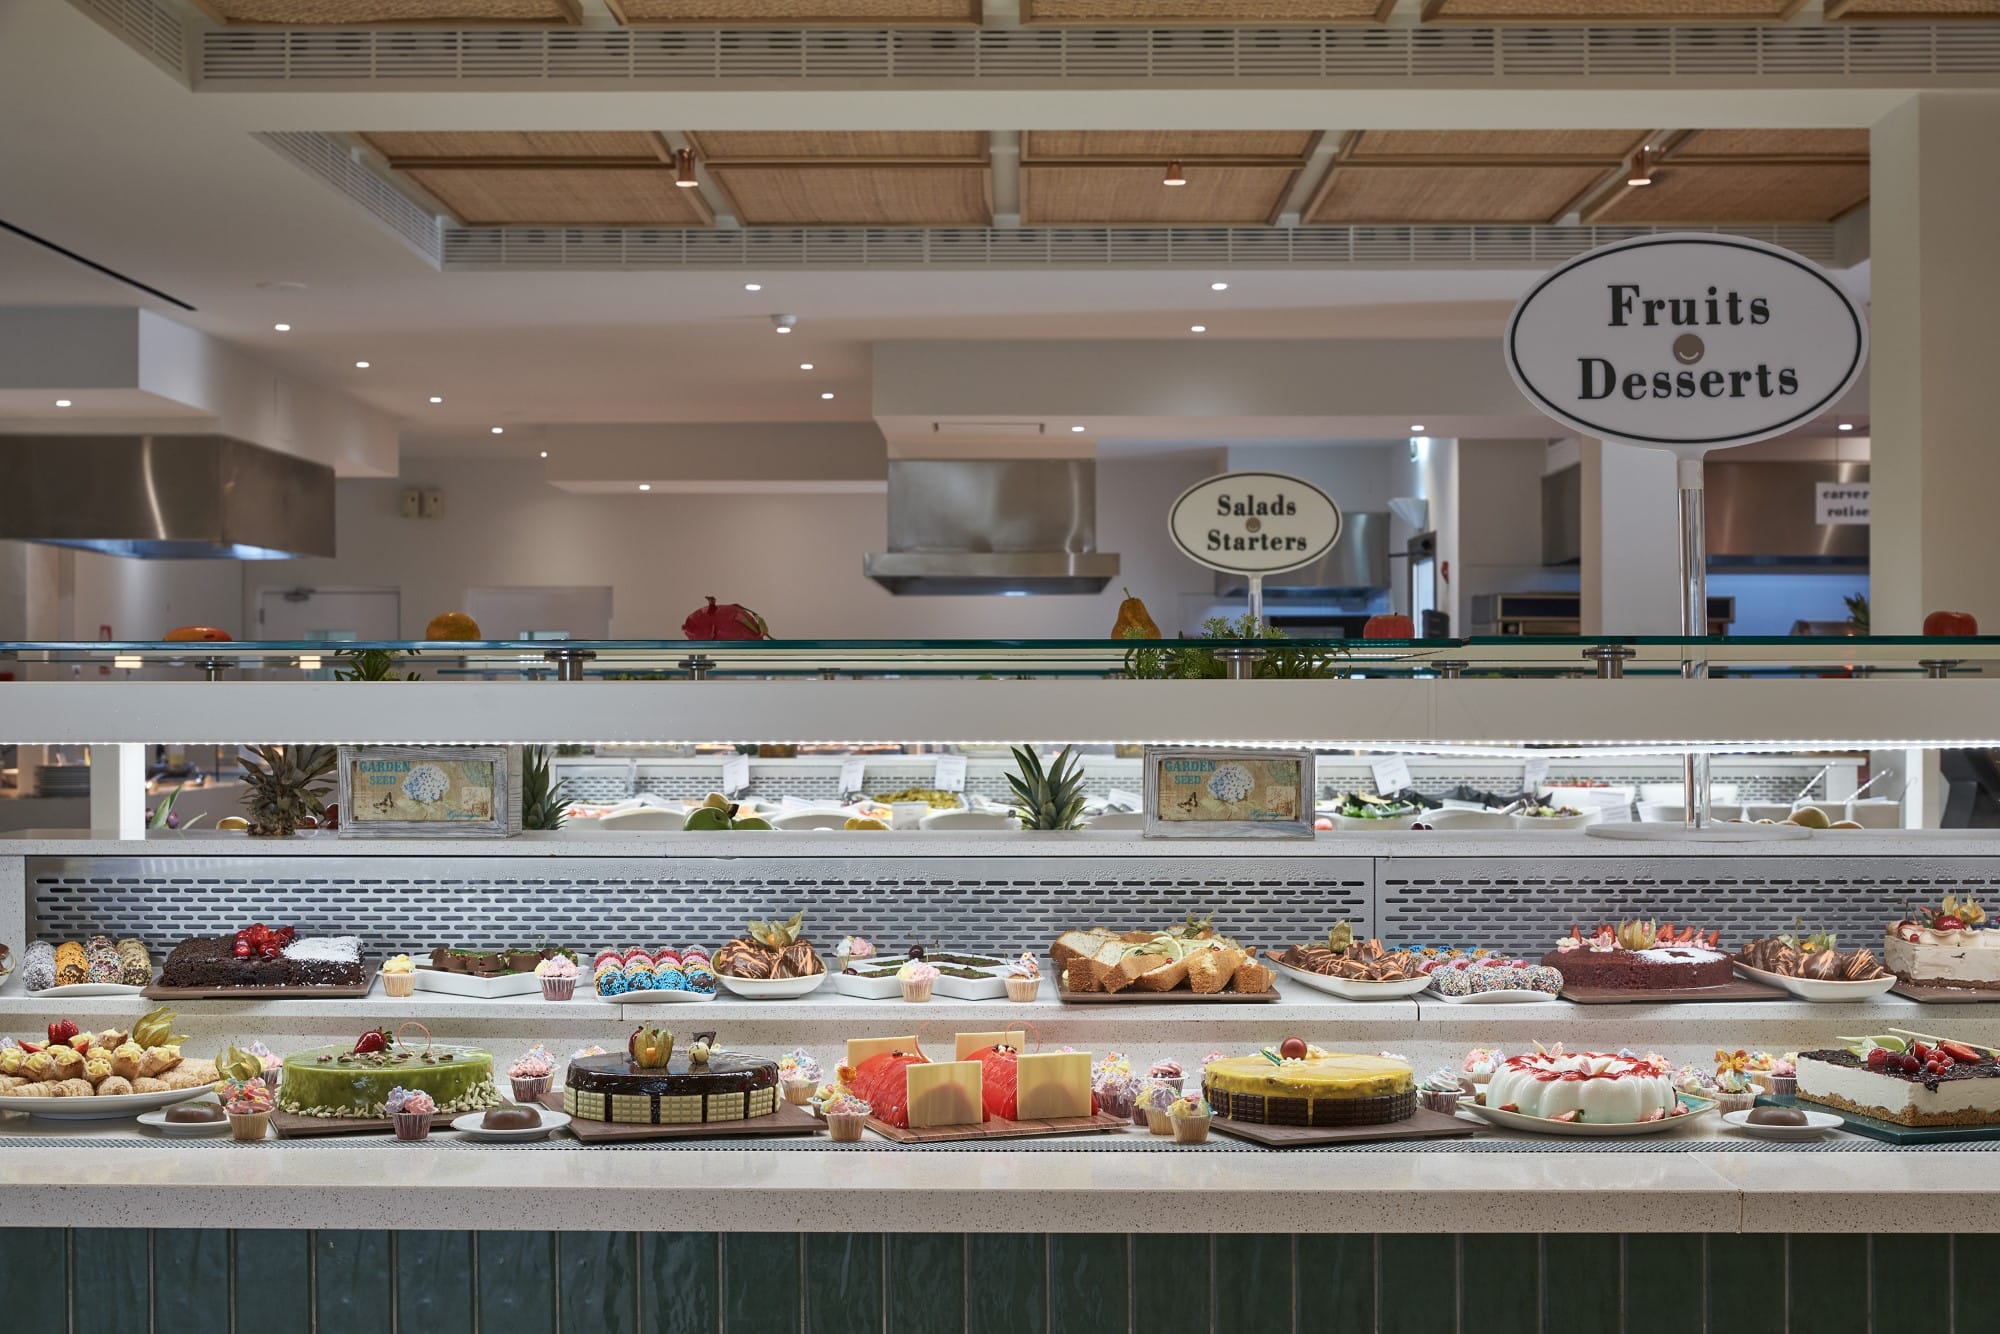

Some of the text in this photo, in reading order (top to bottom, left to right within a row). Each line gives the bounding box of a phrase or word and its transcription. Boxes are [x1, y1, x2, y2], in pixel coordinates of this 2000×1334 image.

[1607, 284, 1771, 327] Fruits
[1576, 357, 1800, 401] Desserts
[1217, 493, 1297, 516] Salads
[1207, 528, 1307, 551] Starters
[358, 760, 411, 773] GARDEN
[1164, 760, 1217, 772] GARDEN
[369, 775, 397, 785] SEED
[1174, 775, 1201, 785] SEED
